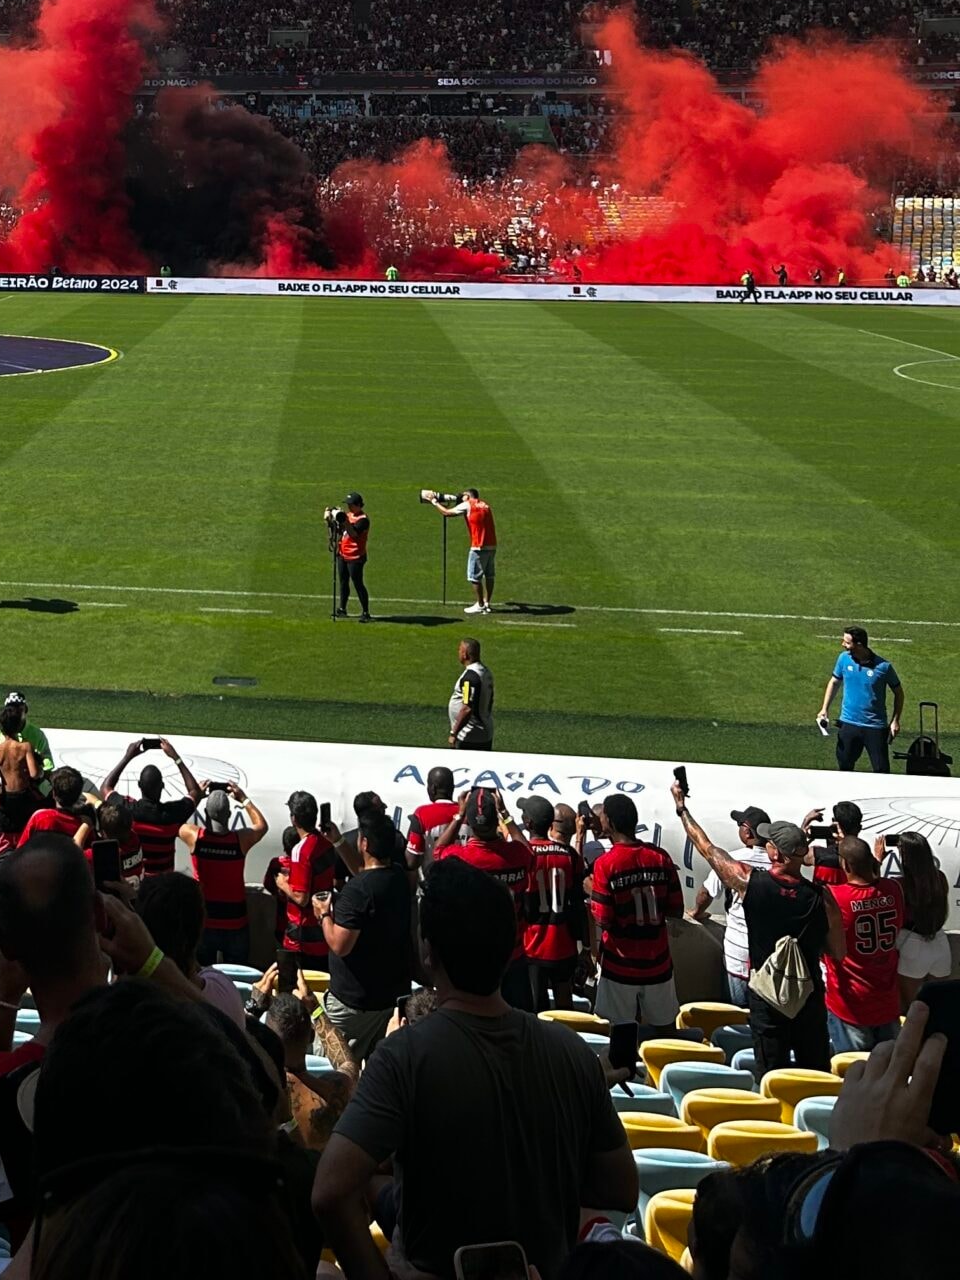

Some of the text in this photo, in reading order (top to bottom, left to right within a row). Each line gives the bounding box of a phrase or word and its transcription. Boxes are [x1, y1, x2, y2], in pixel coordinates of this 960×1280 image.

[437, 78, 461, 86] SEJA
[462, 76, 544, 86] SÓCIO-TORCEDOR
[562, 76, 597, 87] NAÇÃO
[52, 277, 98, 289] Betano
[101, 278, 139, 290] 2024
[278, 283, 460, 295] BAIXE O FLA-APP NO SEU CELULAR
[764, 290, 813, 300] FLA-APP
[815, 291, 833, 300] NO
[835, 291, 858, 301] SEU
[859, 291, 913, 301] CELULAR
[393, 764, 646, 795] A CASA DO
[536, 867, 566, 913] 10
[631, 885, 661, 927] 11
[854, 910, 898, 956] 95
